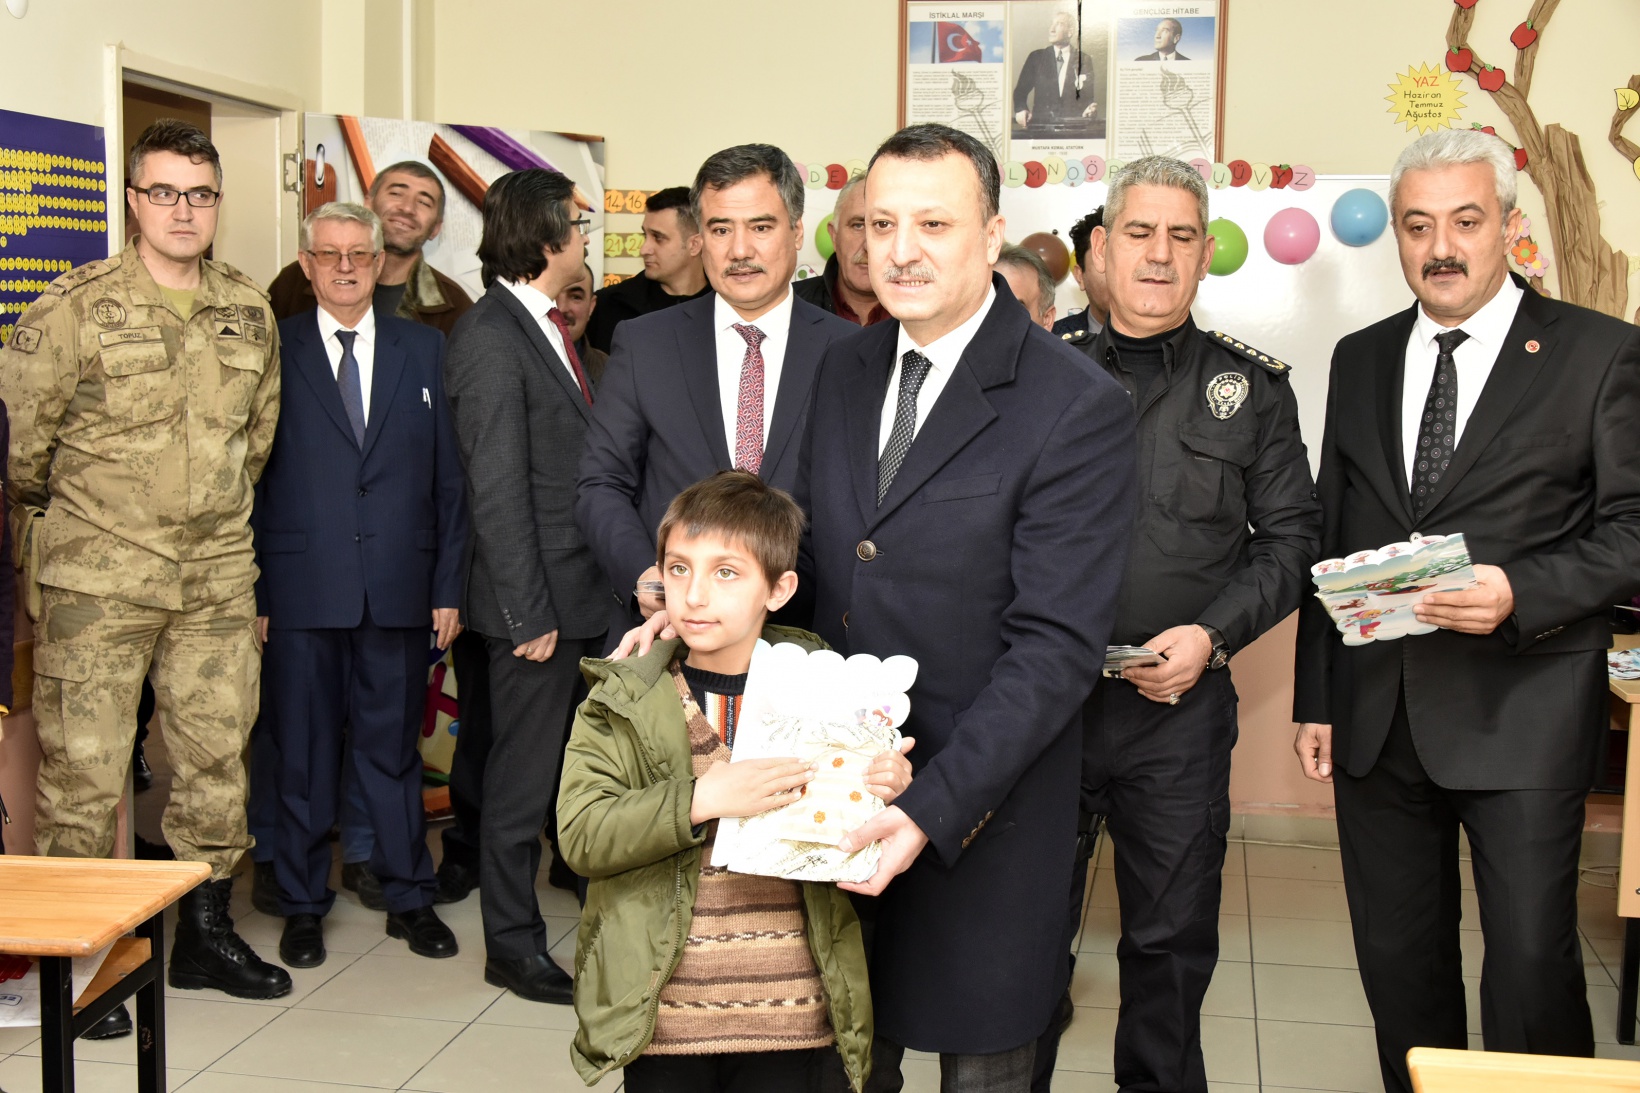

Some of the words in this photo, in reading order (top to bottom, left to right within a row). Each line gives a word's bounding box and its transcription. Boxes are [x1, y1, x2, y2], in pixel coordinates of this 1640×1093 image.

[929, 11, 960, 19] İSTİKLAL
[1172, 7, 1200, 15] HİTABE
[1413, 76, 1440, 88] YAZ
[1403, 90, 1442, 99] Haziran
[1405, 110, 1442, 122] Ağustos
[810, 170, 820, 182] D
[830, 170, 840, 183] E
[1009, 167, 1019, 181] L
[1026, 167, 1040, 180] M
[1047, 163, 1059, 175] N
[1067, 166, 1079, 180] O
[1086, 160, 1098, 175] Ö
[1213, 171, 1225, 184] U
[1233, 164, 1244, 179] Ü
[1254, 170, 1267, 185] V
[1275, 171, 1286, 185] Y
[1294, 172, 1308, 186] Z
[605, 194, 621, 209] 14
[629, 195, 642, 209] 16
[606, 238, 620, 252] 21
